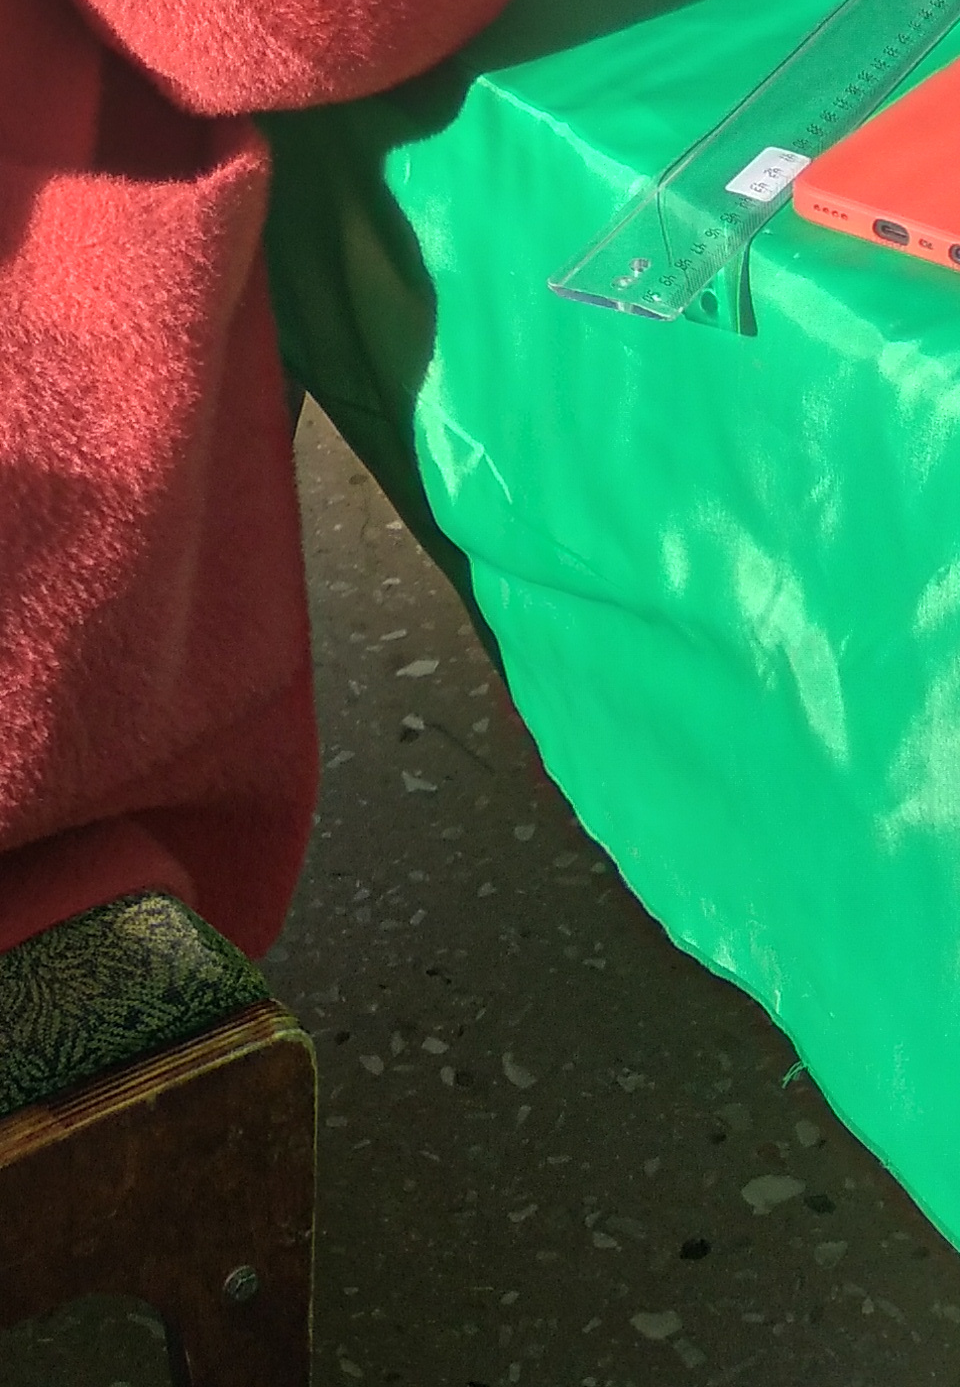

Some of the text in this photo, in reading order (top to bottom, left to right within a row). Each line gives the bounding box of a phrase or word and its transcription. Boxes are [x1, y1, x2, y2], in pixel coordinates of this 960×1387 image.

[764, 166, 783, 179] 42
[751, 182, 769, 193] 43
[704, 226, 722, 239] 46
[691, 243, 706, 255] 47
[674, 257, 692, 272] 48
[661, 274, 677, 287] 49
